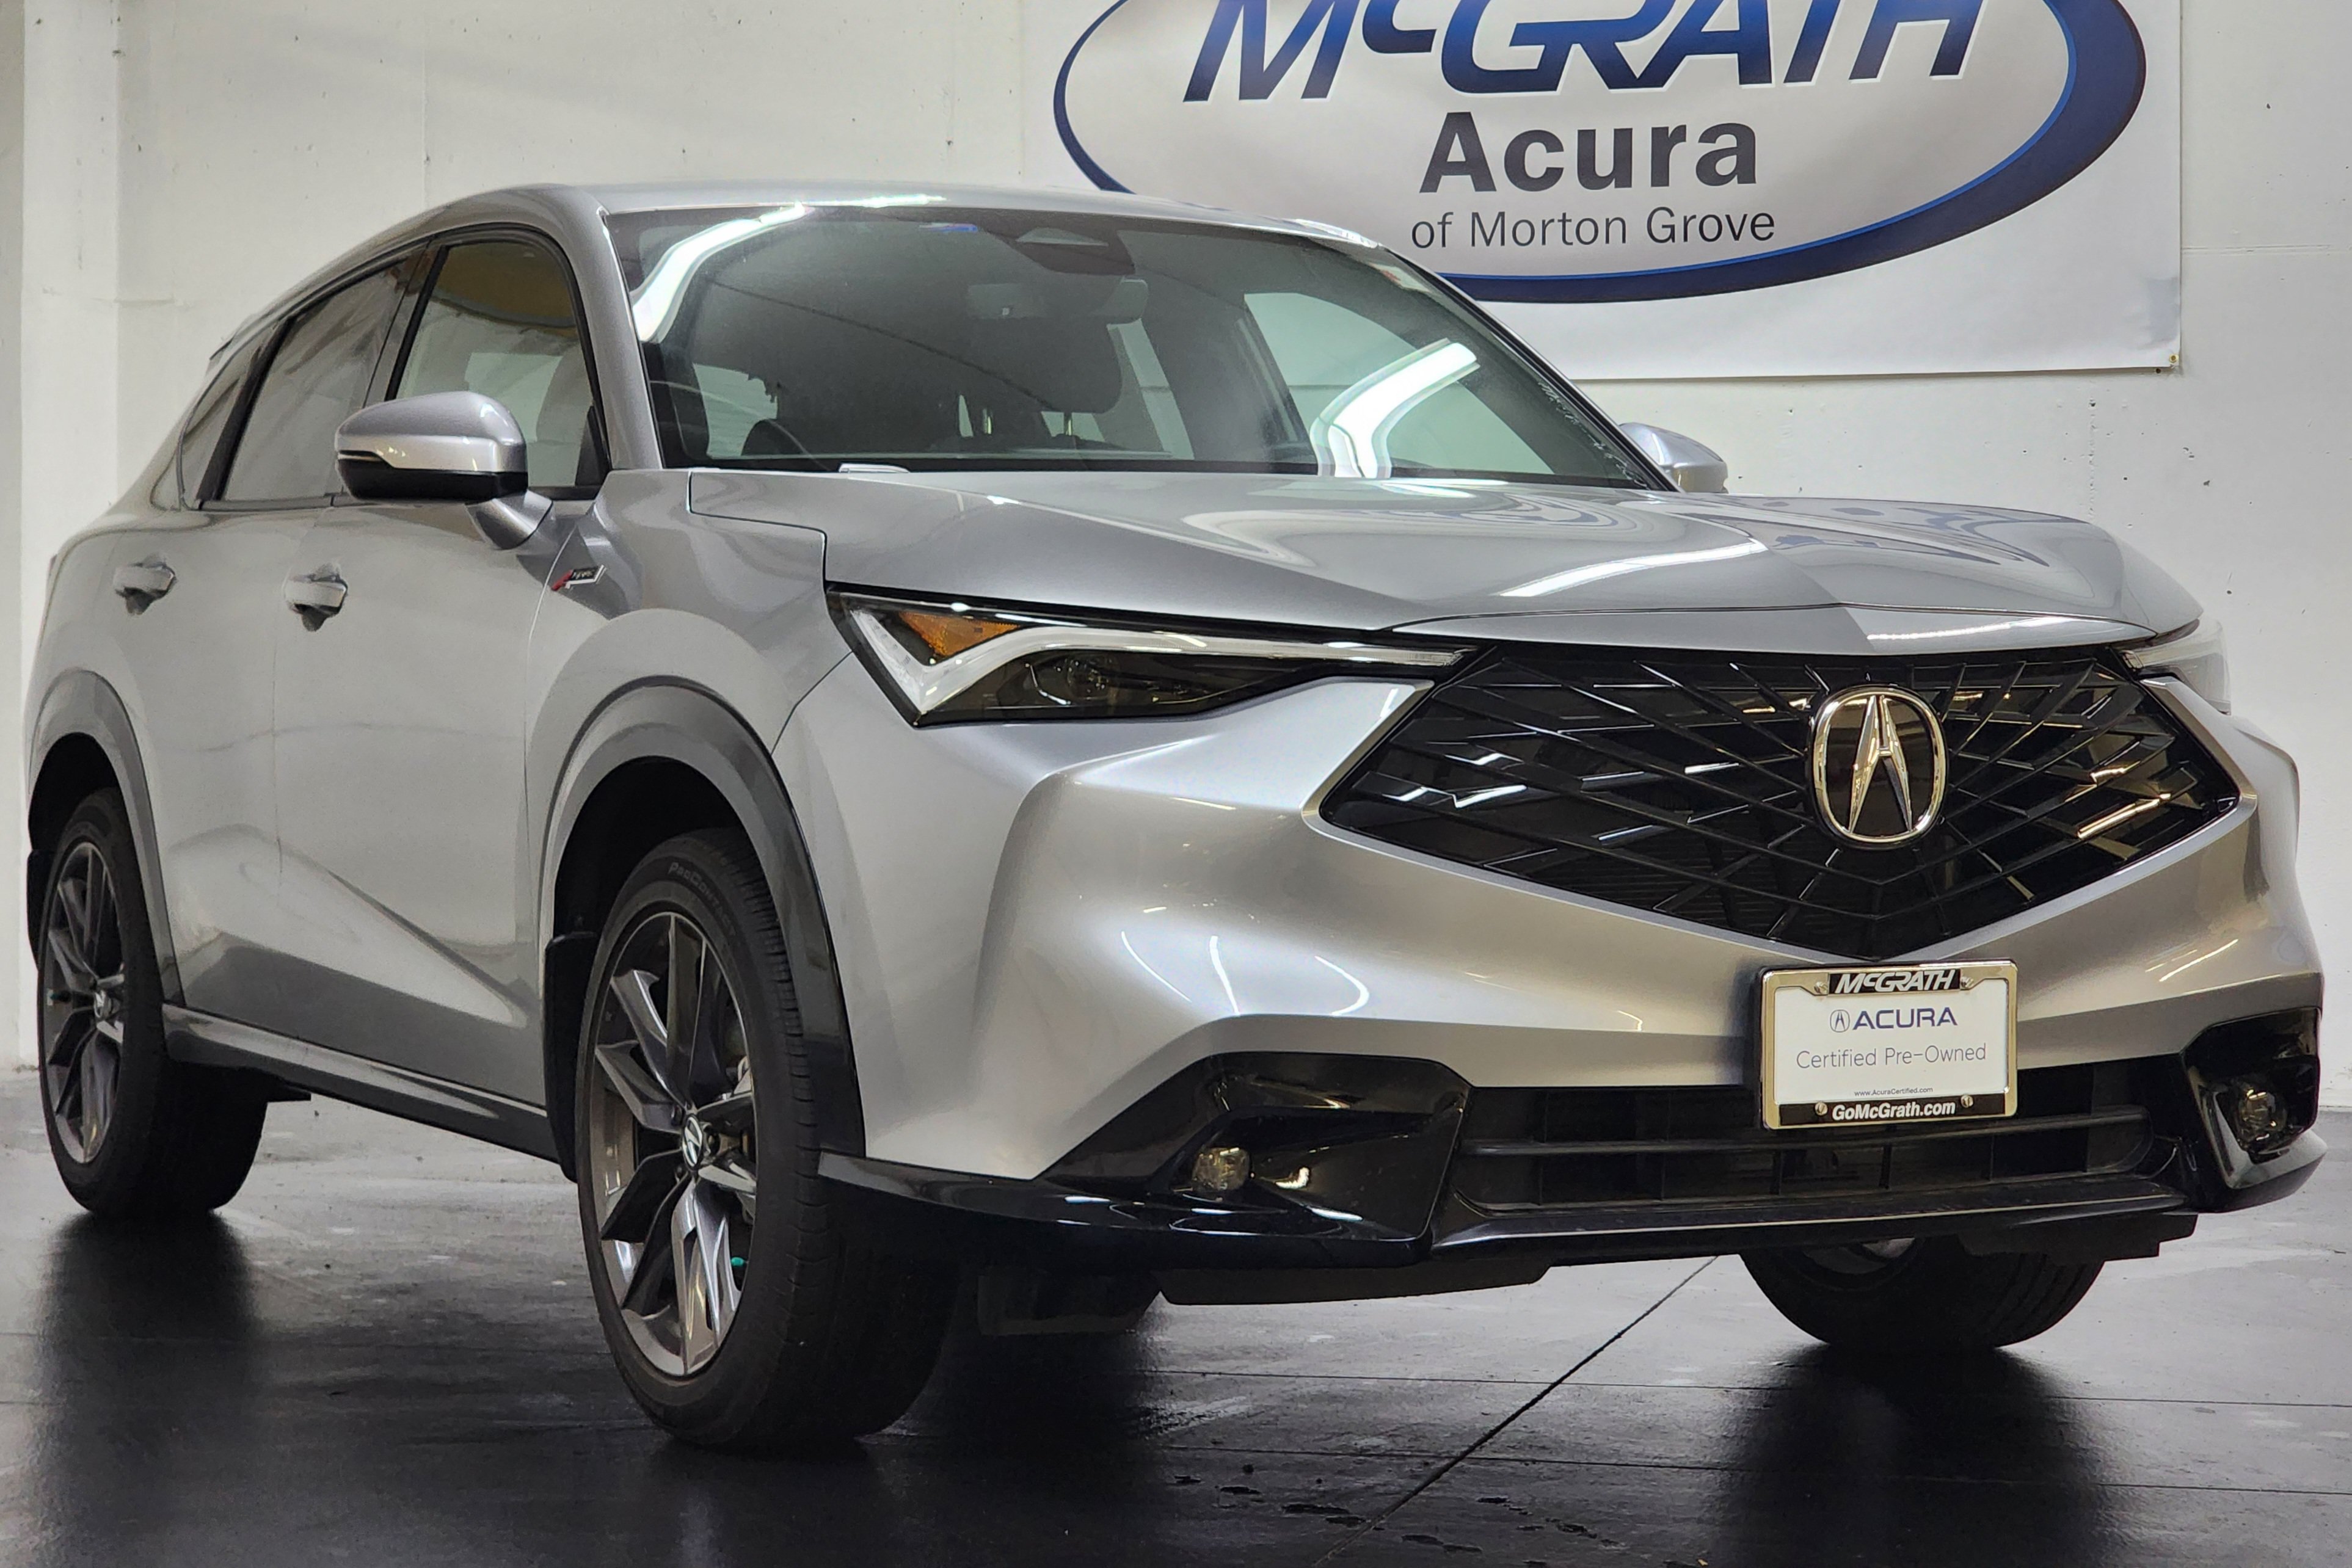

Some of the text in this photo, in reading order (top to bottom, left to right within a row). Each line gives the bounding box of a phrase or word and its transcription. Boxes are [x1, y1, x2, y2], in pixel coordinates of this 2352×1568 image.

[1419, 111, 1757, 193] Acura
[1411, 206, 1775, 248] of Morton Grove
[1852, 1007, 1958, 1030] ACURA
[1796, 1042, 1986, 1069] Certified Pre-Owned
[1854, 1086, 1933, 1097] www.AcuraCertified.com
[1832, 1101, 1956, 1121] GoMcGrath.com
